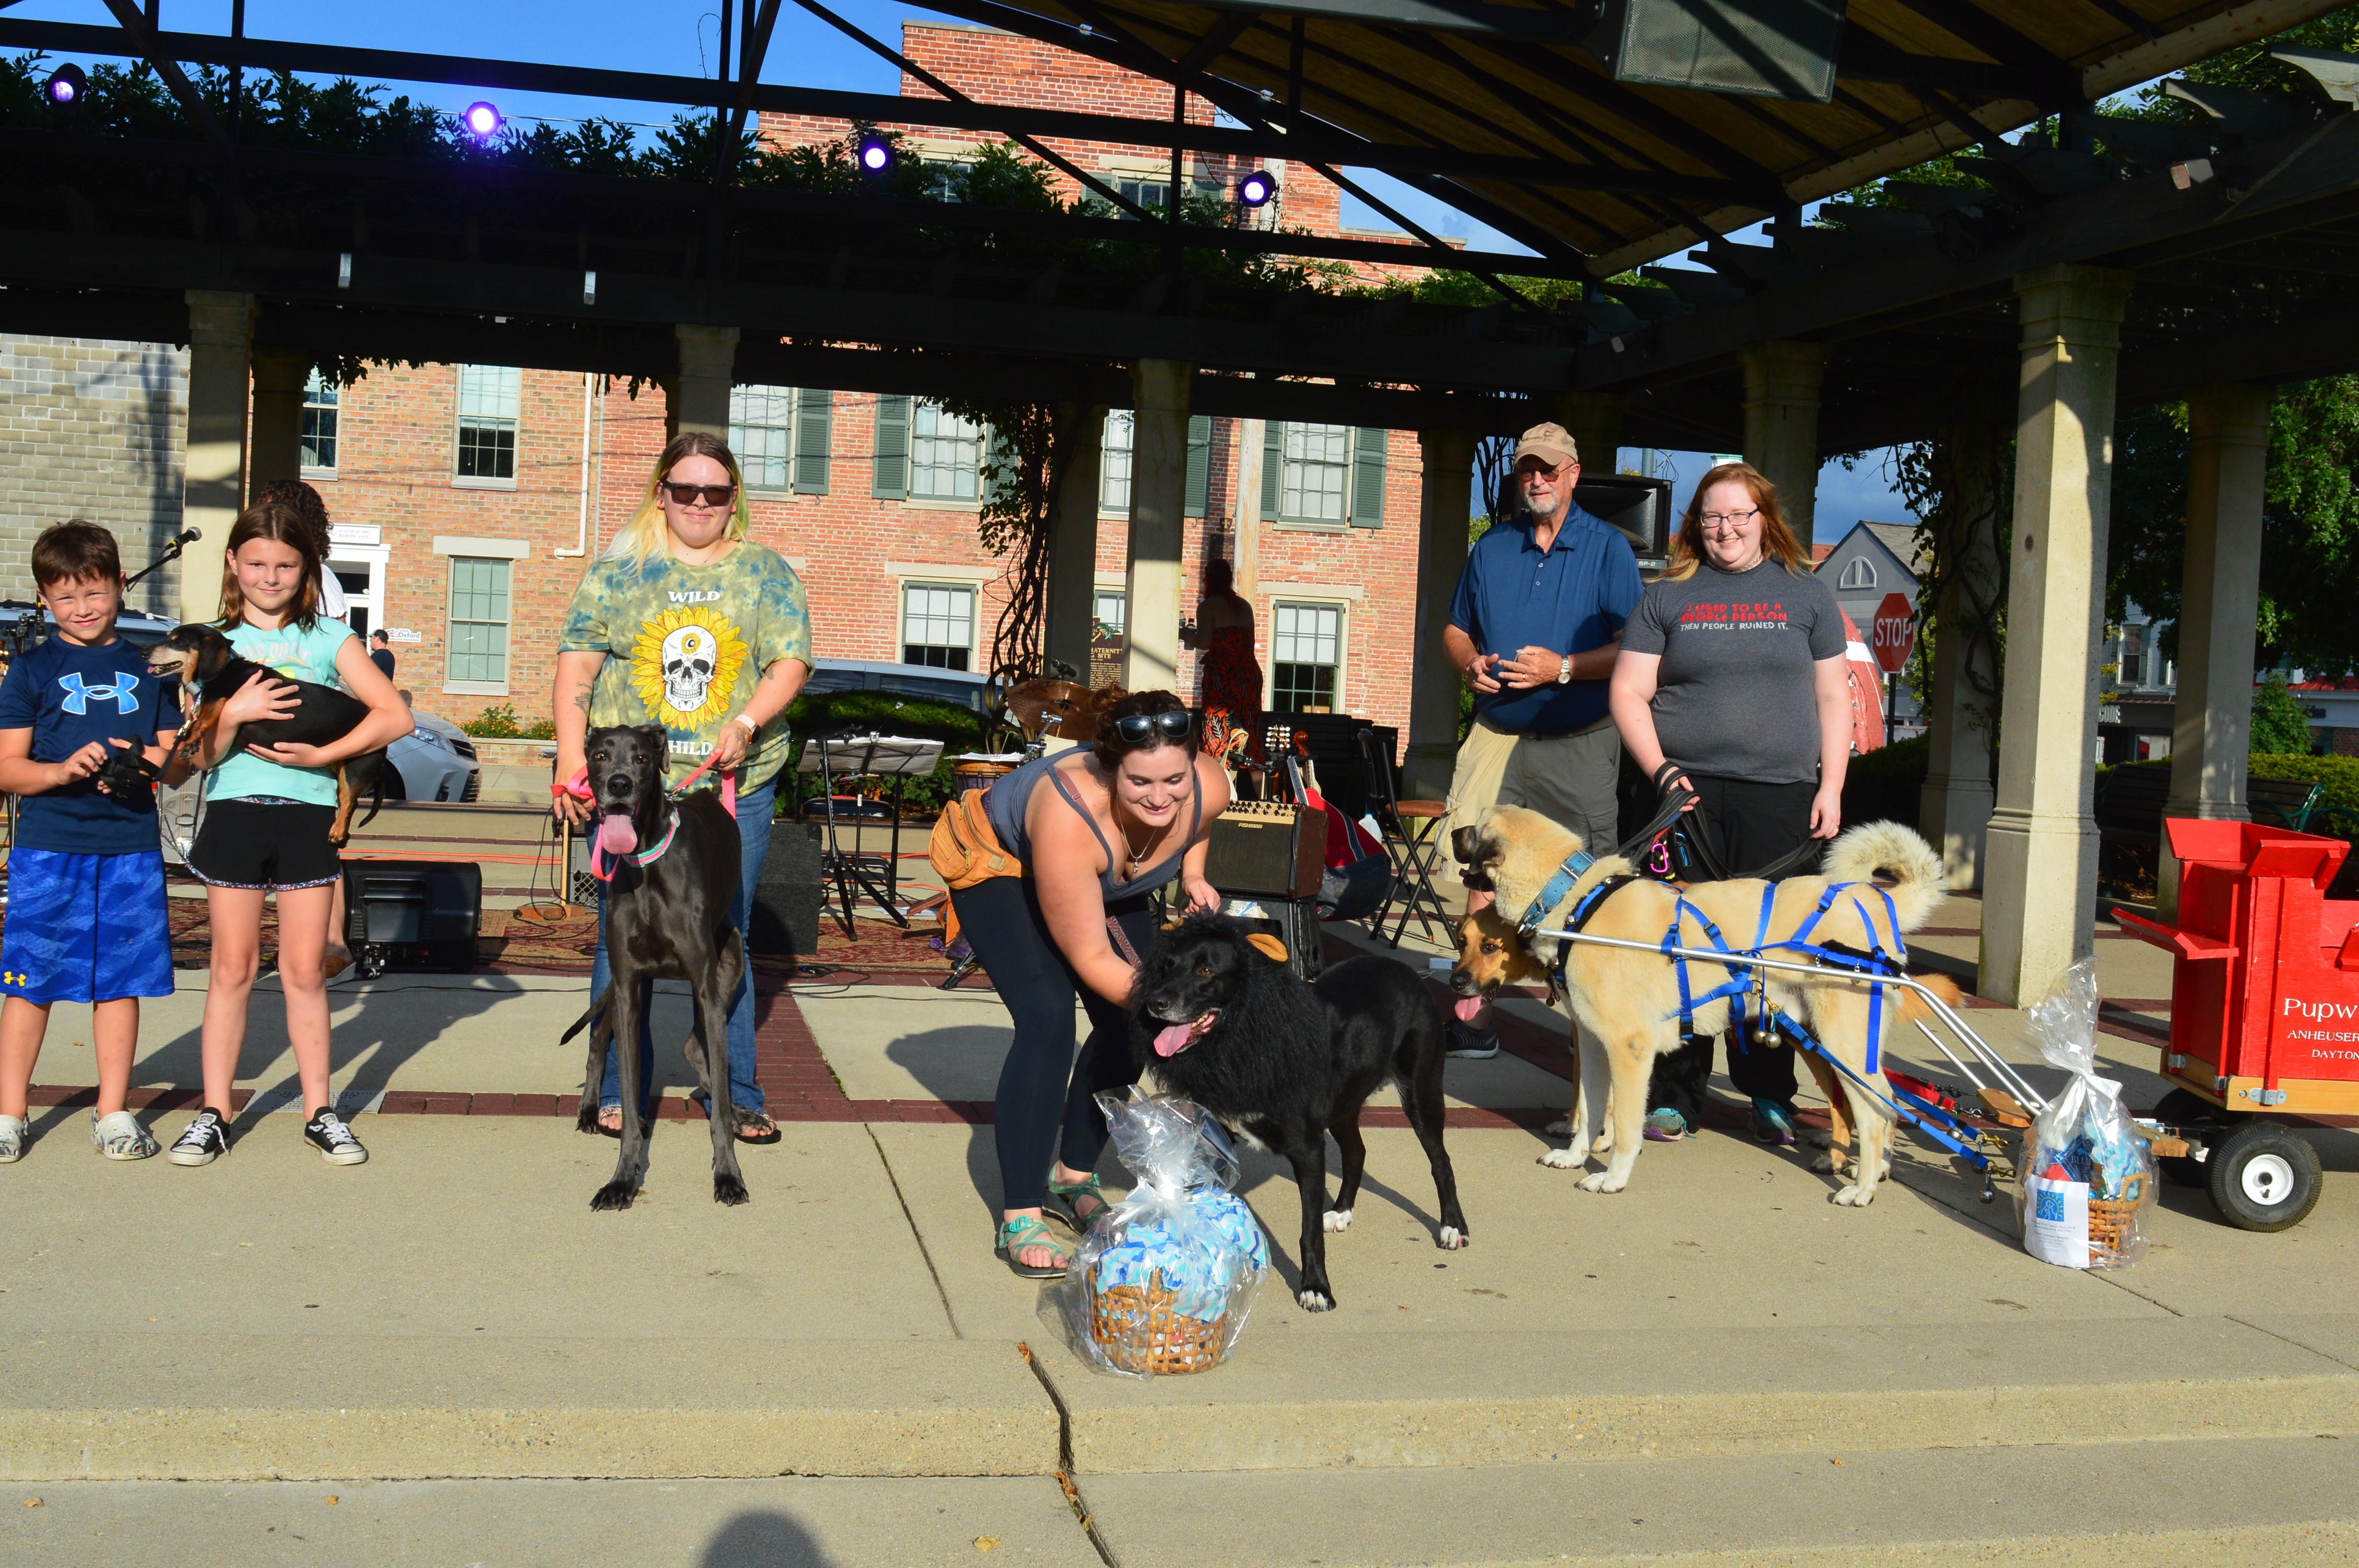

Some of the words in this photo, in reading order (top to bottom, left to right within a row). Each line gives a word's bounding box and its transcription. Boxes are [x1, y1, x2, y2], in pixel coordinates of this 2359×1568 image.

[668, 591, 720, 603] WILD
[1687, 604, 1692, 613] I
[1695, 603, 1727, 613] USED
[1732, 603, 1750, 613] TO
[1754, 603, 1769, 612] BE
[1774, 602, 1782, 611] A
[1681, 612, 1728, 624] PEOPLE
[1732, 612, 1788, 622] PERSON
[1680, 622, 1700, 632] THEN
[1702, 622, 1735, 630] PEOPLE
[1739, 621, 1774, 630] RUINED
[1778, 622, 1789, 630] IT.
[1875, 617, 1912, 647] STOP
[668, 740, 713, 756] HILD
